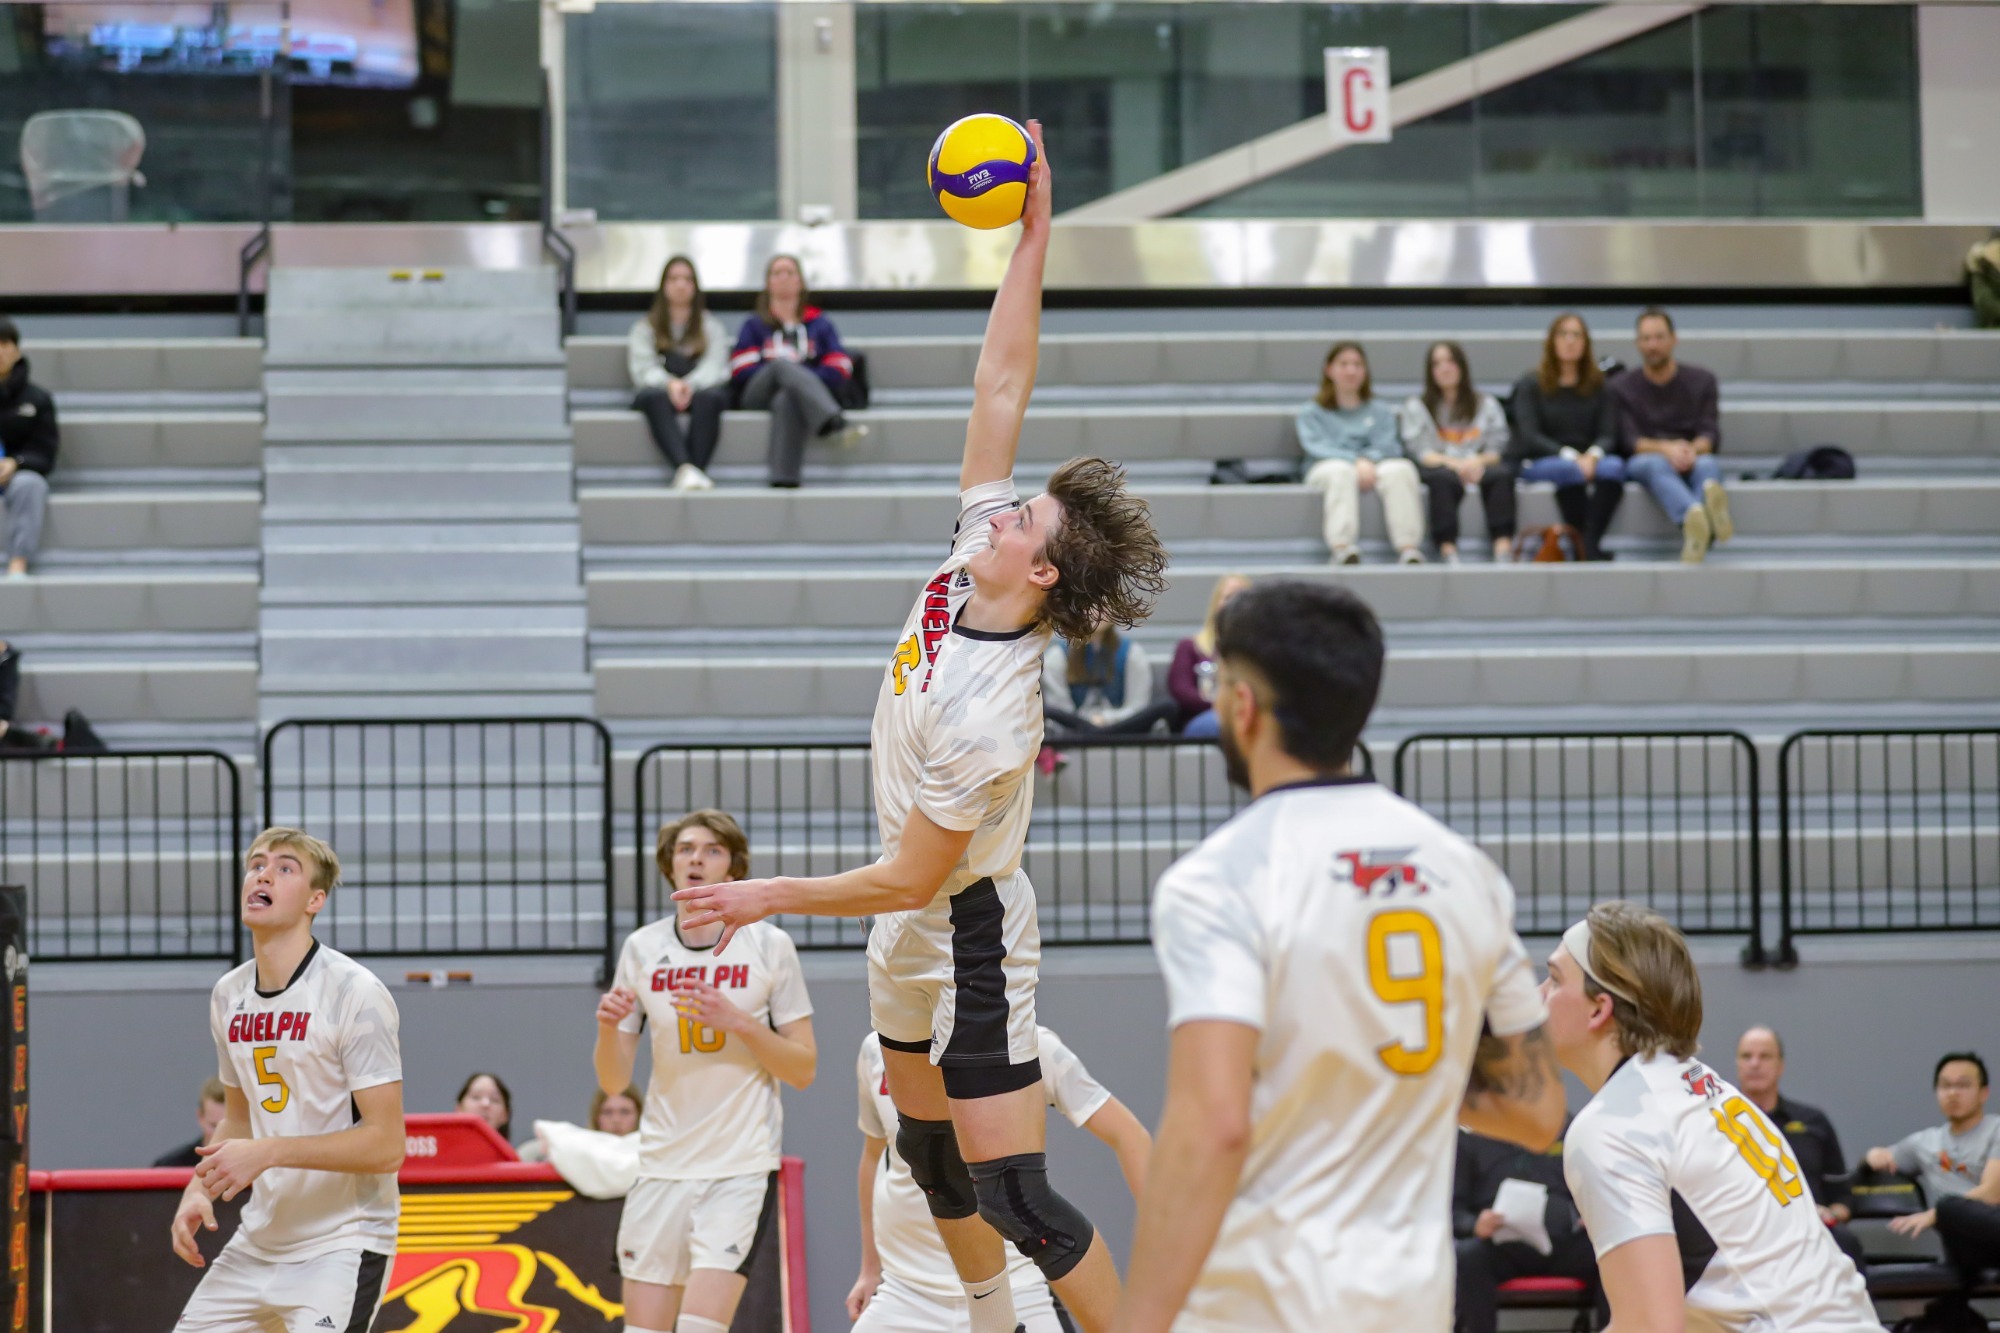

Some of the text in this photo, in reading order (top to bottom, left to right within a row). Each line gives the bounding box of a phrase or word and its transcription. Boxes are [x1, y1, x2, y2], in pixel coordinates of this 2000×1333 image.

[1343, 66, 1375, 134] C
[1366, 908, 1445, 1076] 9
[228, 1011, 312, 1043] GUELPH
[253, 1046, 290, 1113] 5
[1710, 1096, 1803, 1207] 10
